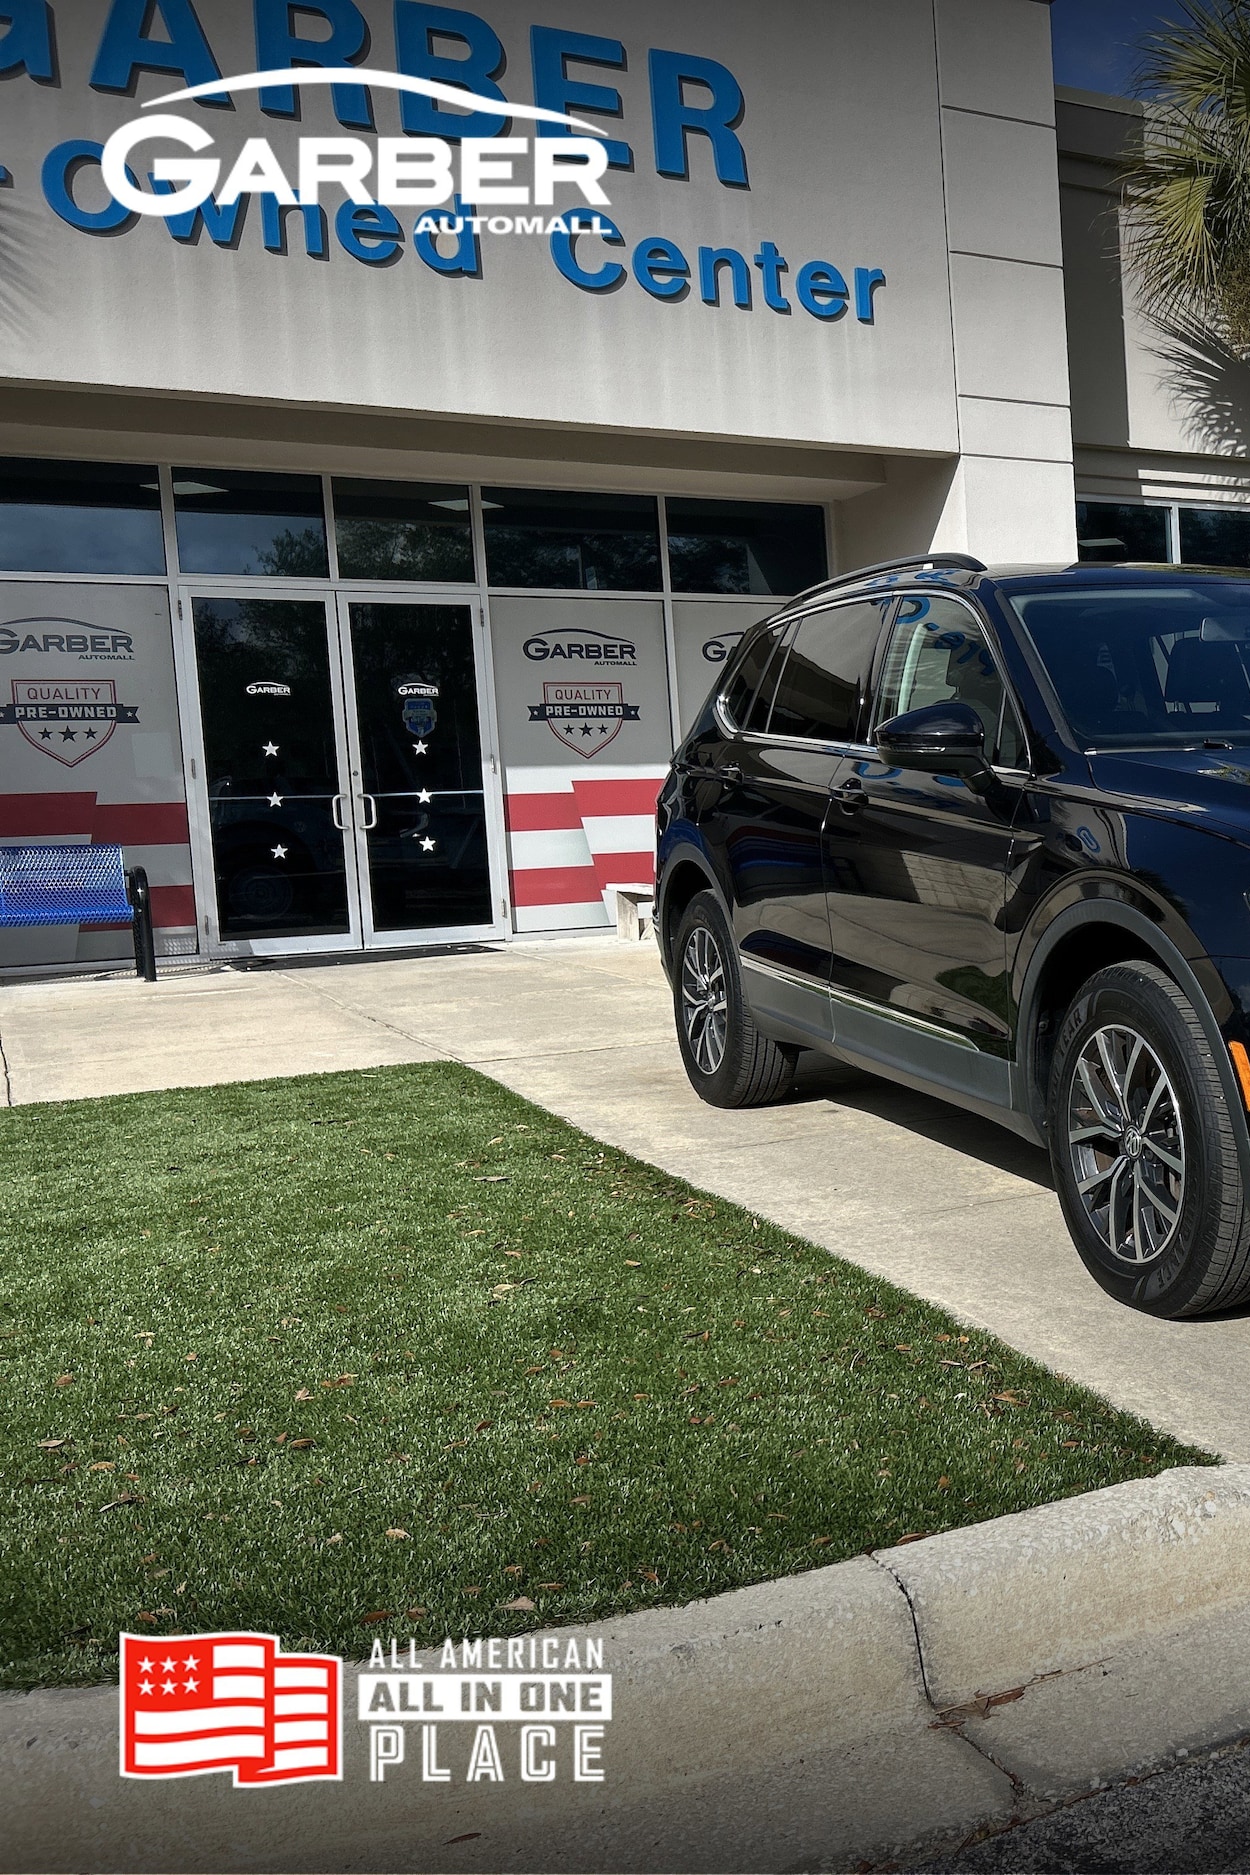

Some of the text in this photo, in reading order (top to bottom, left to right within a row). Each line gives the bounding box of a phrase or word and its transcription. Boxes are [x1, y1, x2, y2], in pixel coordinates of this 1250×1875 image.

[0, 0, 748, 187] ARBER
[549, 207, 884, 323] Center
[522, 638, 637, 661] GARBER
[27, 687, 101, 701] QUALITY
[554, 689, 612, 701] QUALITY
[15, 705, 117, 719] PRE-OWNED
[545, 705, 624, 717] PRE-OWNED
